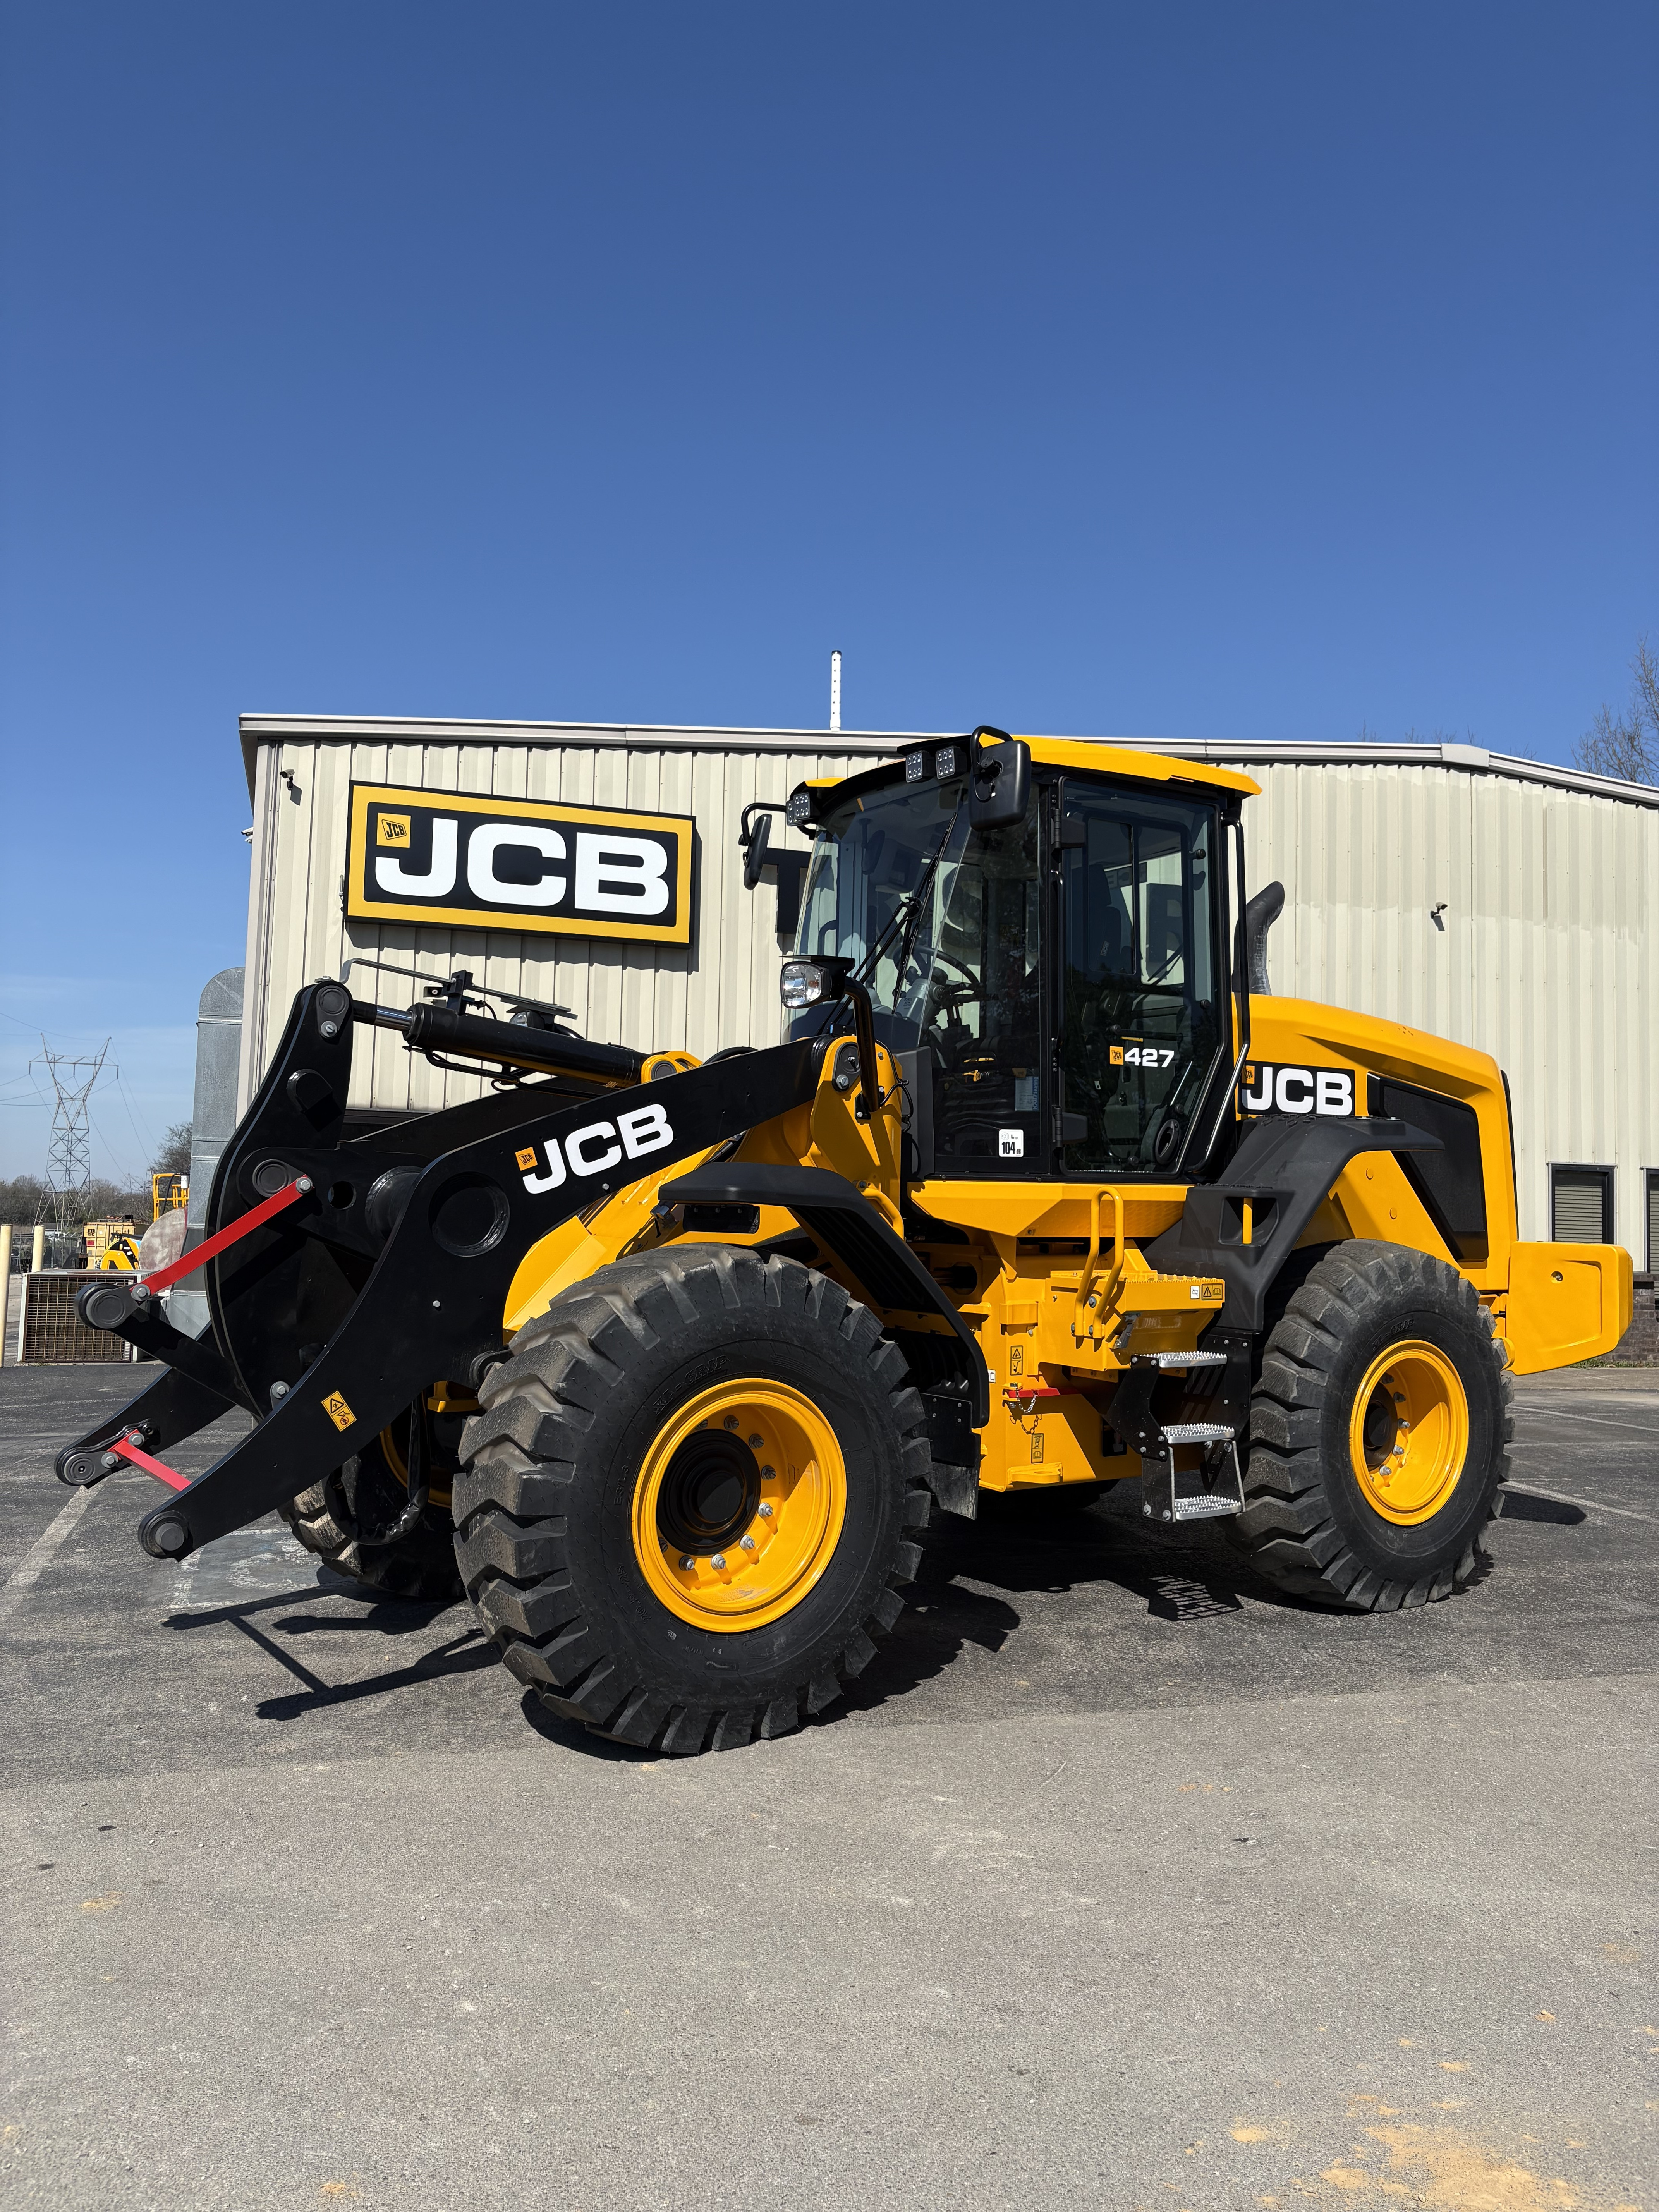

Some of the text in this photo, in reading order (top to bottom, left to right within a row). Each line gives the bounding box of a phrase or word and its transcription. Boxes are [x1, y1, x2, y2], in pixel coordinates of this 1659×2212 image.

[386, 822, 405, 838] JCB
[375, 817, 669, 915] JCB
[1113, 1051, 1122, 1060] JCB
[1125, 1048, 1174, 1068] 427
[1242, 1066, 1353, 1116] JCB
[522, 1104, 674, 1194] JCB
[1001, 1141, 1015, 1154] 104
[521, 1154, 532, 1164] JCB
